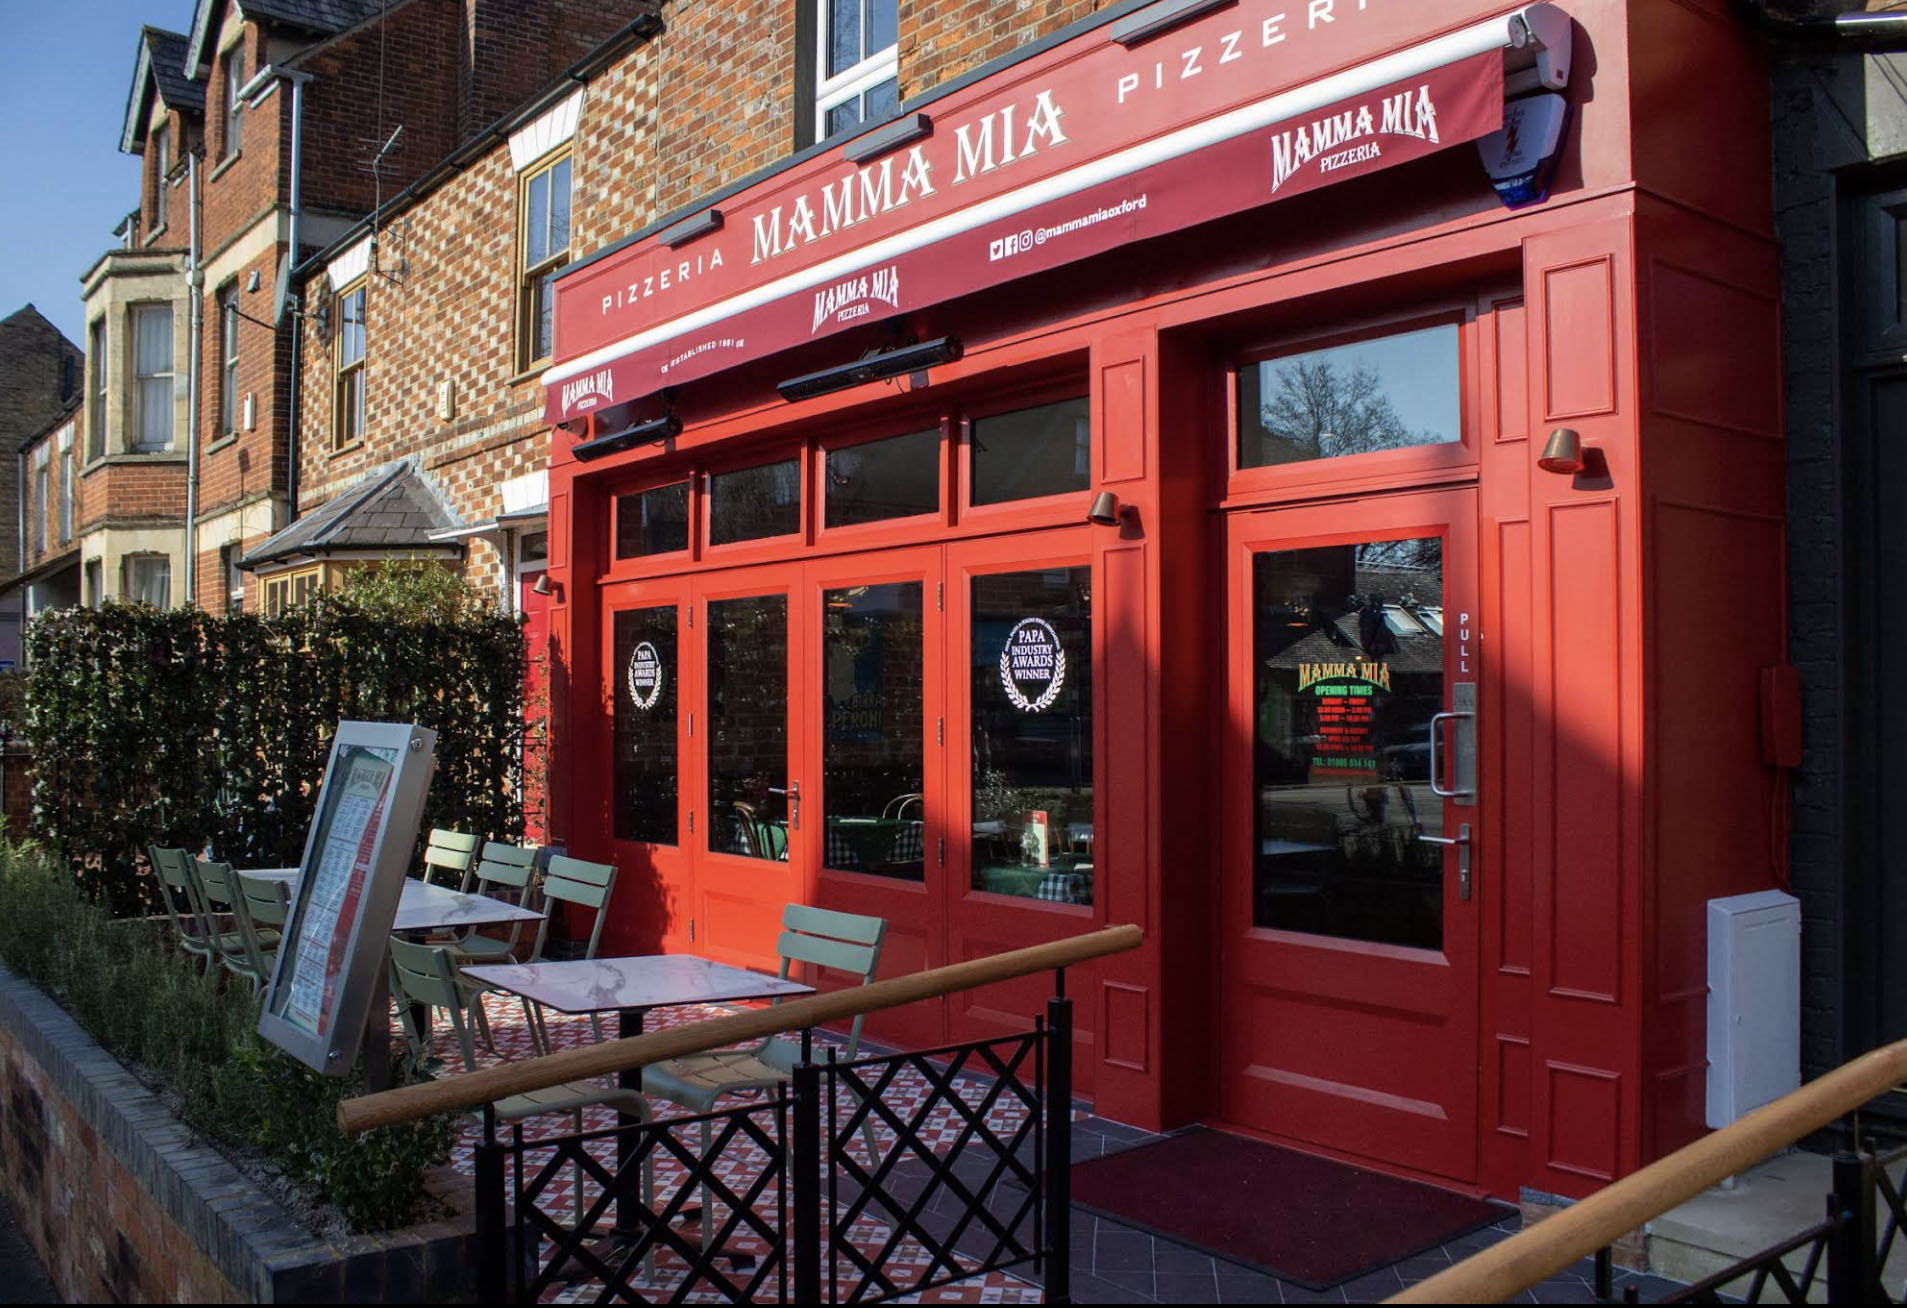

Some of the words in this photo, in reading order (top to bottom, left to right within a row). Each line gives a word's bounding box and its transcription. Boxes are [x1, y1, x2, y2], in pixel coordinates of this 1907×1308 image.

[1271, 105, 1375, 193] MAMMA
[1379, 84, 1440, 144] MIA
[1320, 141, 1382, 173] PIZZERIA
[750, 144, 939, 265] MAMMA
[951, 88, 1072, 185] MIA
[1035, 193, 1147, 245] @mammamiaoxford
[602, 248, 723, 315] PIZZERIA
[811, 276, 869, 335] MAMMA
[870, 265, 899, 308] MIA
[837, 302, 870, 322] PIZZERIA
[670, 341, 716, 367] ESTABLISHED
[562, 377, 595, 418] MAMMA
[597, 369, 613, 403] MIA
[1011, 644, 1053, 655] INDUSTRY
[1019, 630, 1045, 643] PAPA
[1460, 613, 1469, 672] PULL
[1011, 655, 1053, 668] AWARDS
[1014, 669, 1051, 679] WINNER
[1298, 662, 1358, 693] MAMMA
[1361, 662, 1391, 692] MIA
[1315, 685, 1348, 695] OPENING
[1349, 685, 1373, 696] TIMES
